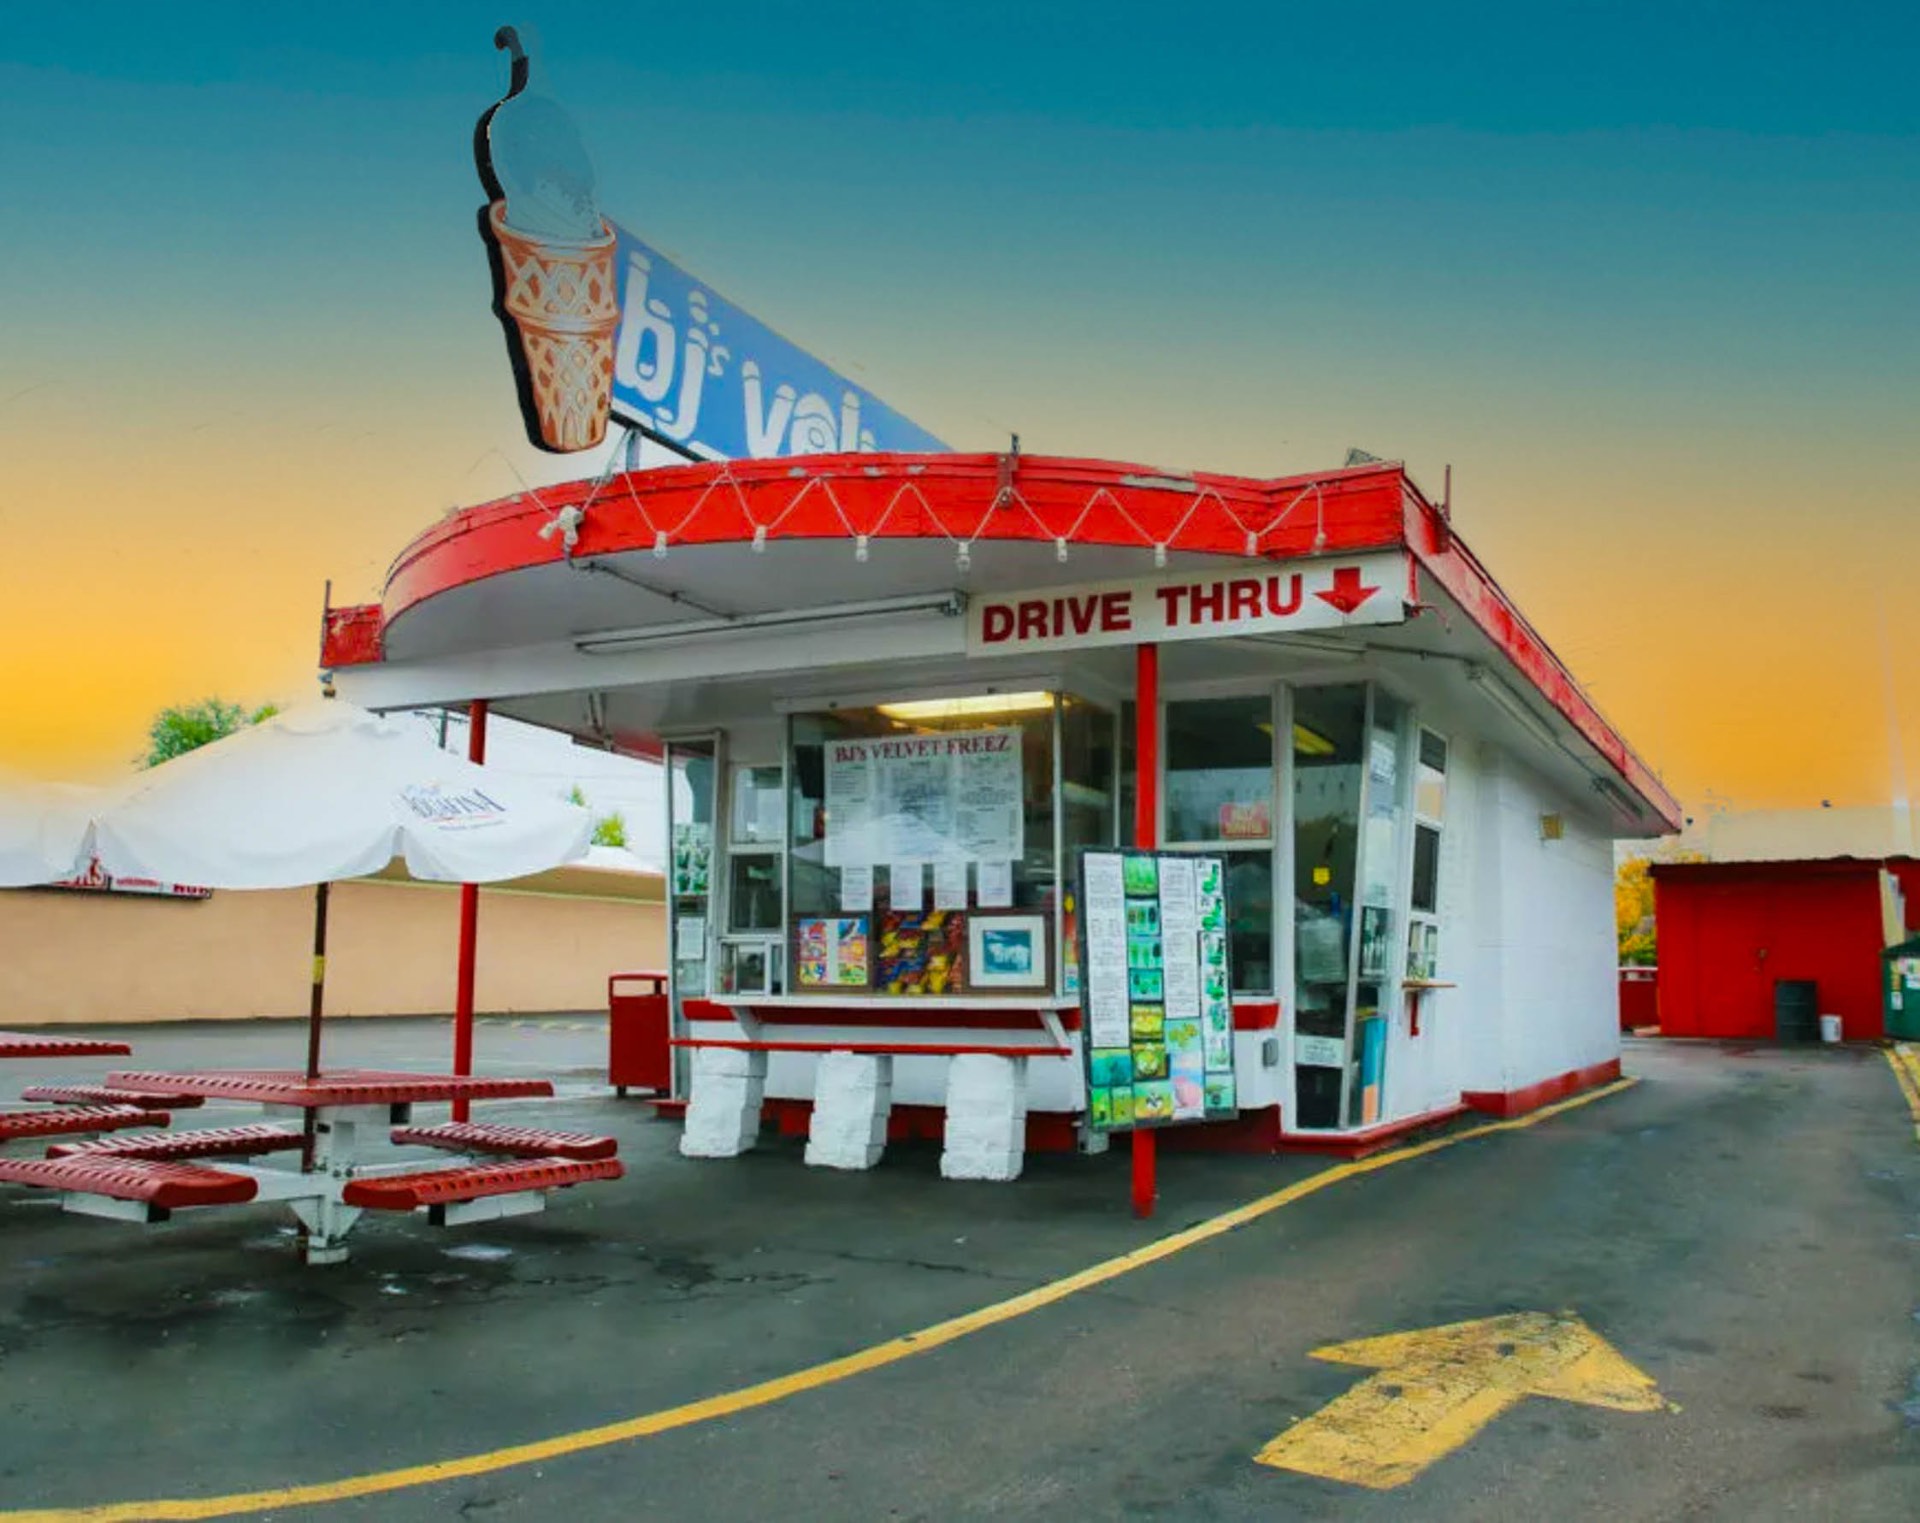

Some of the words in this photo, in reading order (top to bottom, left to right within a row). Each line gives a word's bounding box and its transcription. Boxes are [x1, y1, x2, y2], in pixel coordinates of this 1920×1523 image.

[981, 590, 1133, 643] DRIVE
[1156, 573, 1304, 626] THRU
[871, 740, 943, 759] VELVET
[947, 735, 1009, 755] FREEZ
